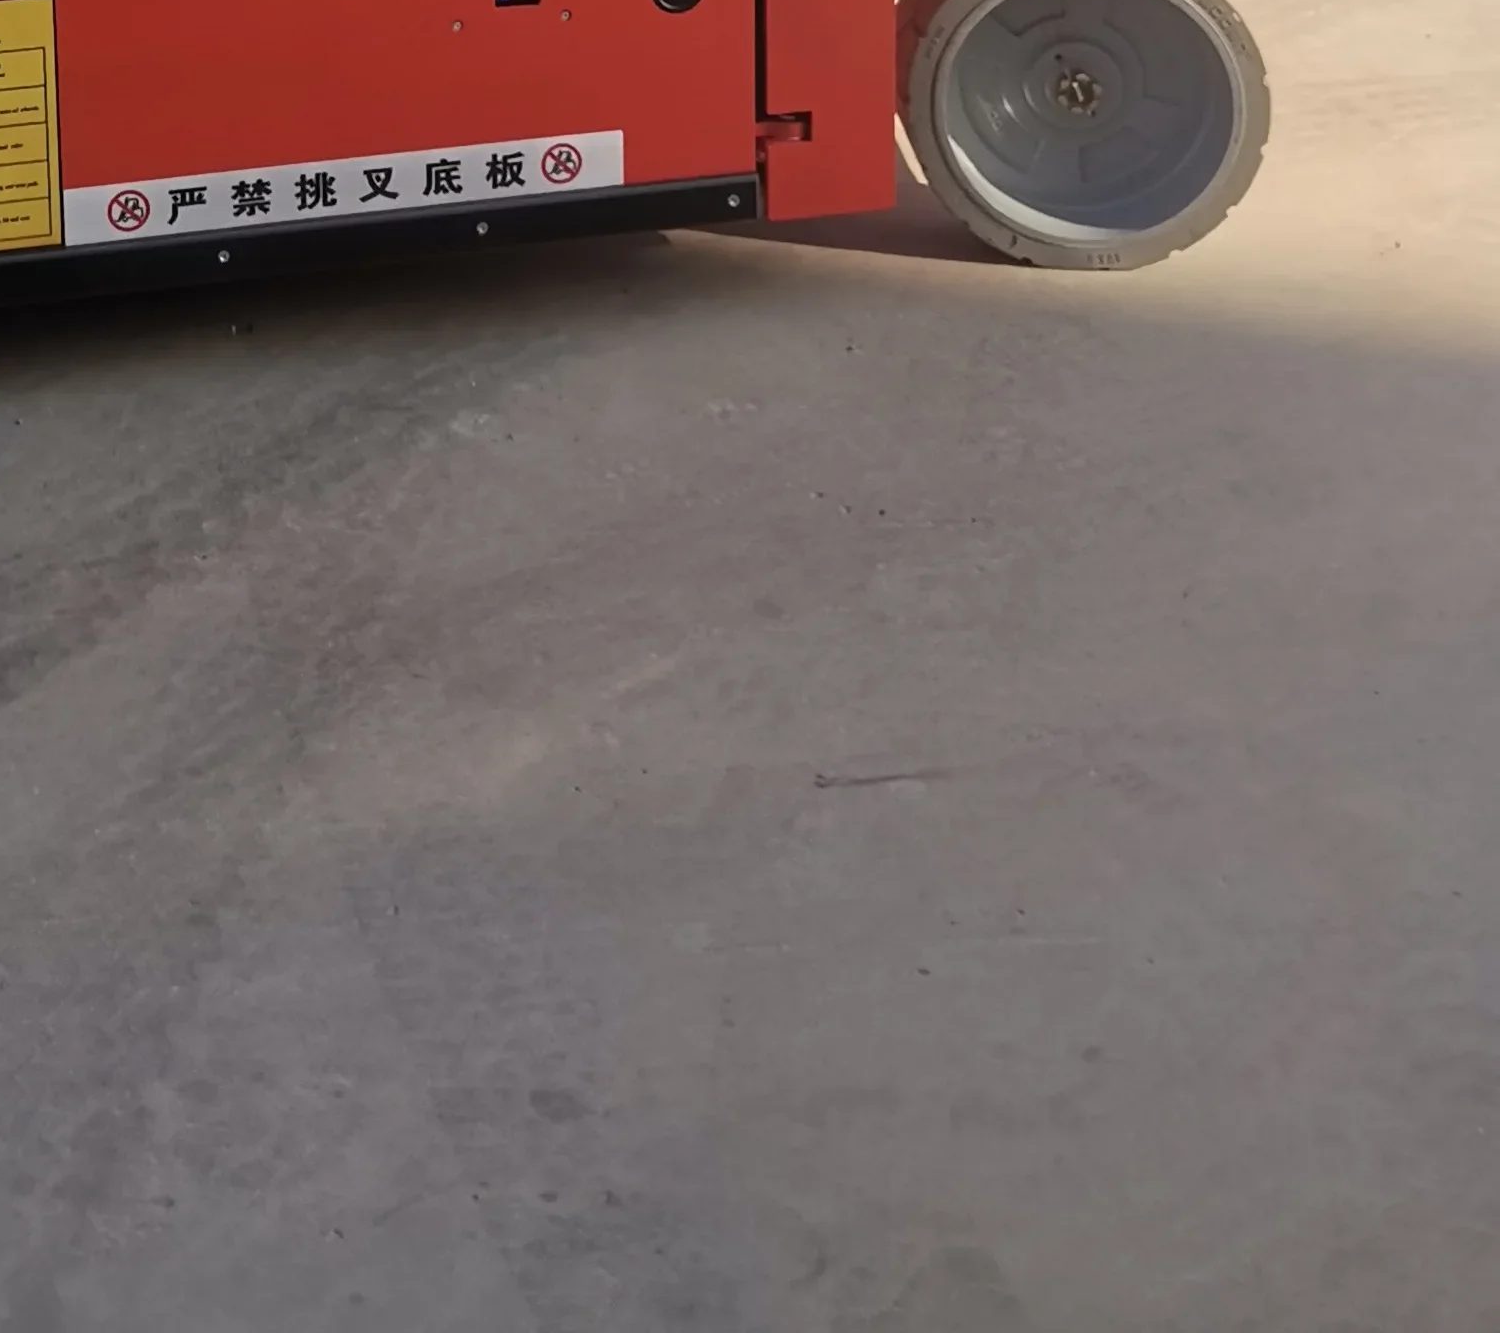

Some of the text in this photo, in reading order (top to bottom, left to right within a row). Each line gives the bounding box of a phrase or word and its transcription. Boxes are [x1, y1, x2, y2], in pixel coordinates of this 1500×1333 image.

[167, 151, 527, 225] 严禁挑叉底板
